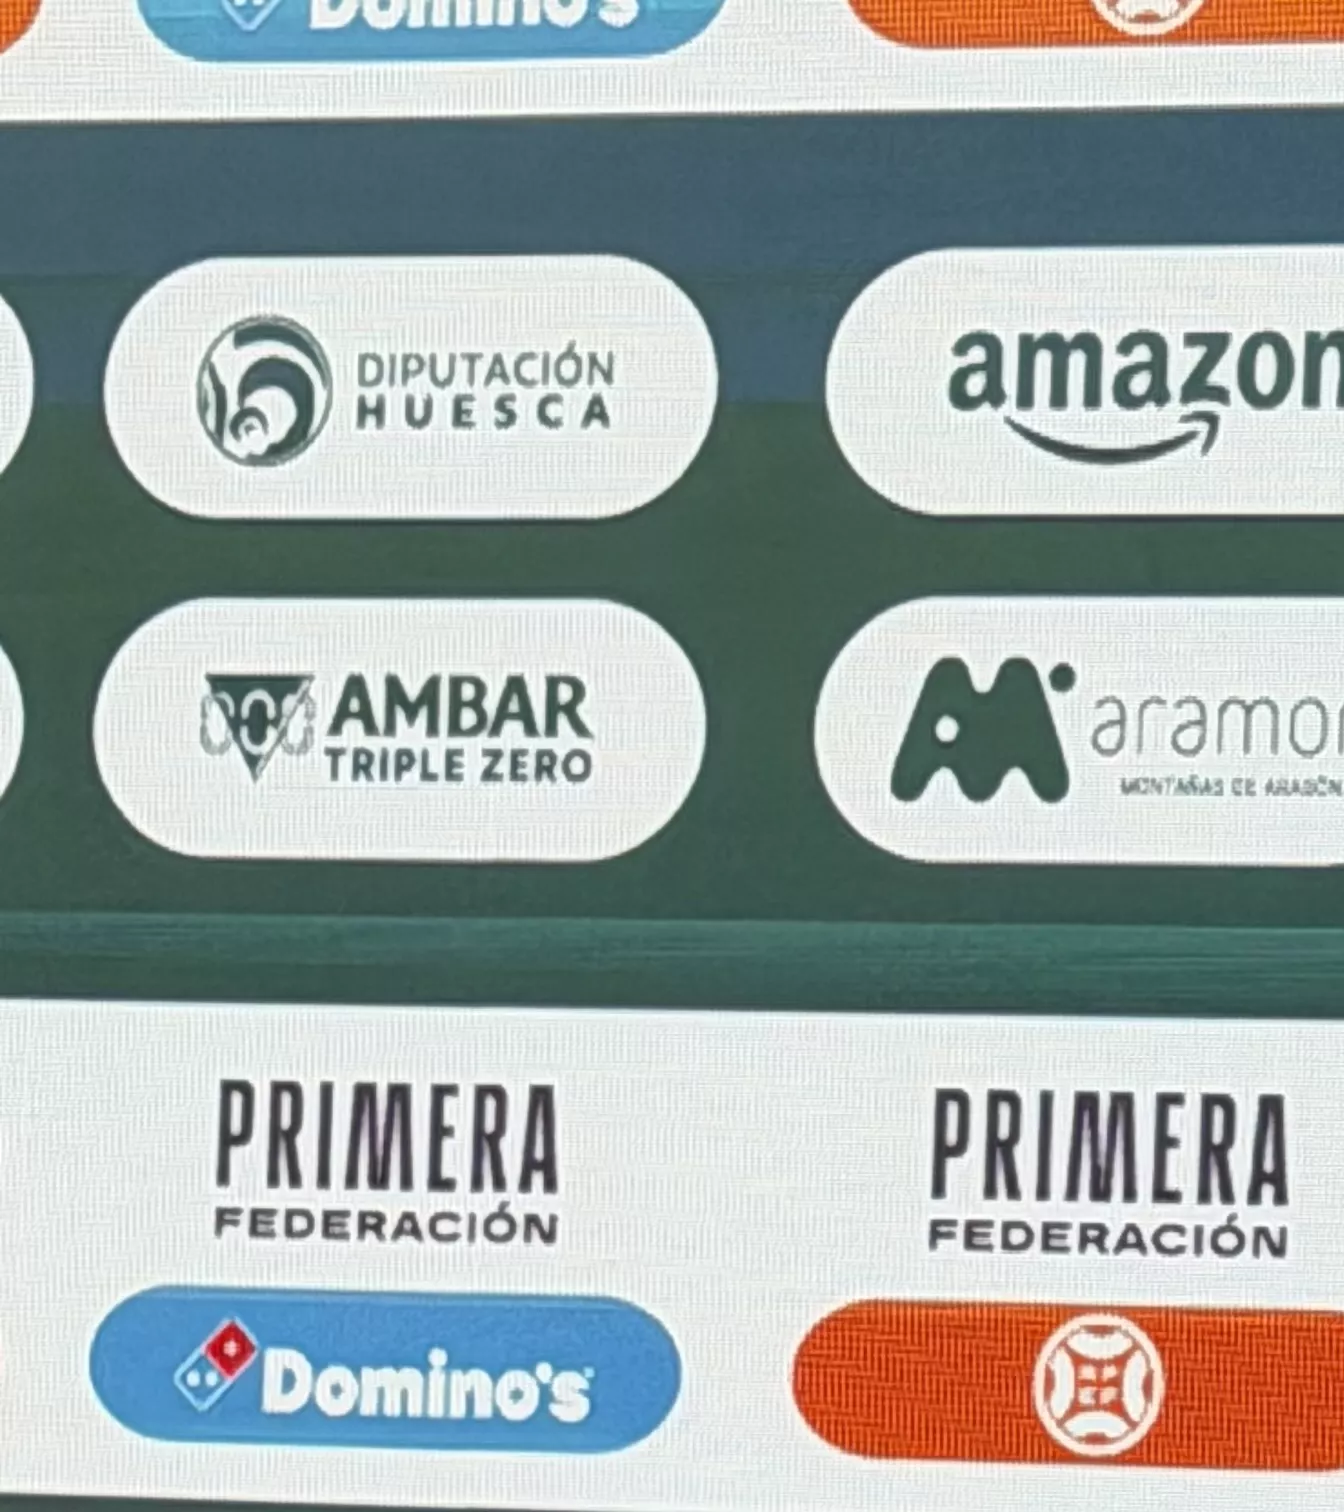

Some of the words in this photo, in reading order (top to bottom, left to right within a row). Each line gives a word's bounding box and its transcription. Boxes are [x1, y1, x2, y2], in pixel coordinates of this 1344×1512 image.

[357, 341, 616, 387] DIPUTACIÓN
[357, 394, 609, 429] HUESCA
[328, 674, 592, 738] AMBAR
[324, 747, 463, 781] TRIPLE
[481, 749, 591, 783] ZERO
[217, 1080, 557, 1193] PRIMERA
[932, 1089, 1288, 1206] PRIMERA
[215, 1201, 558, 1244] FEDERACIÓN
[929, 1213, 1287, 1258] FEDERACIÓN
[263, 1348, 592, 1422] Domino's
